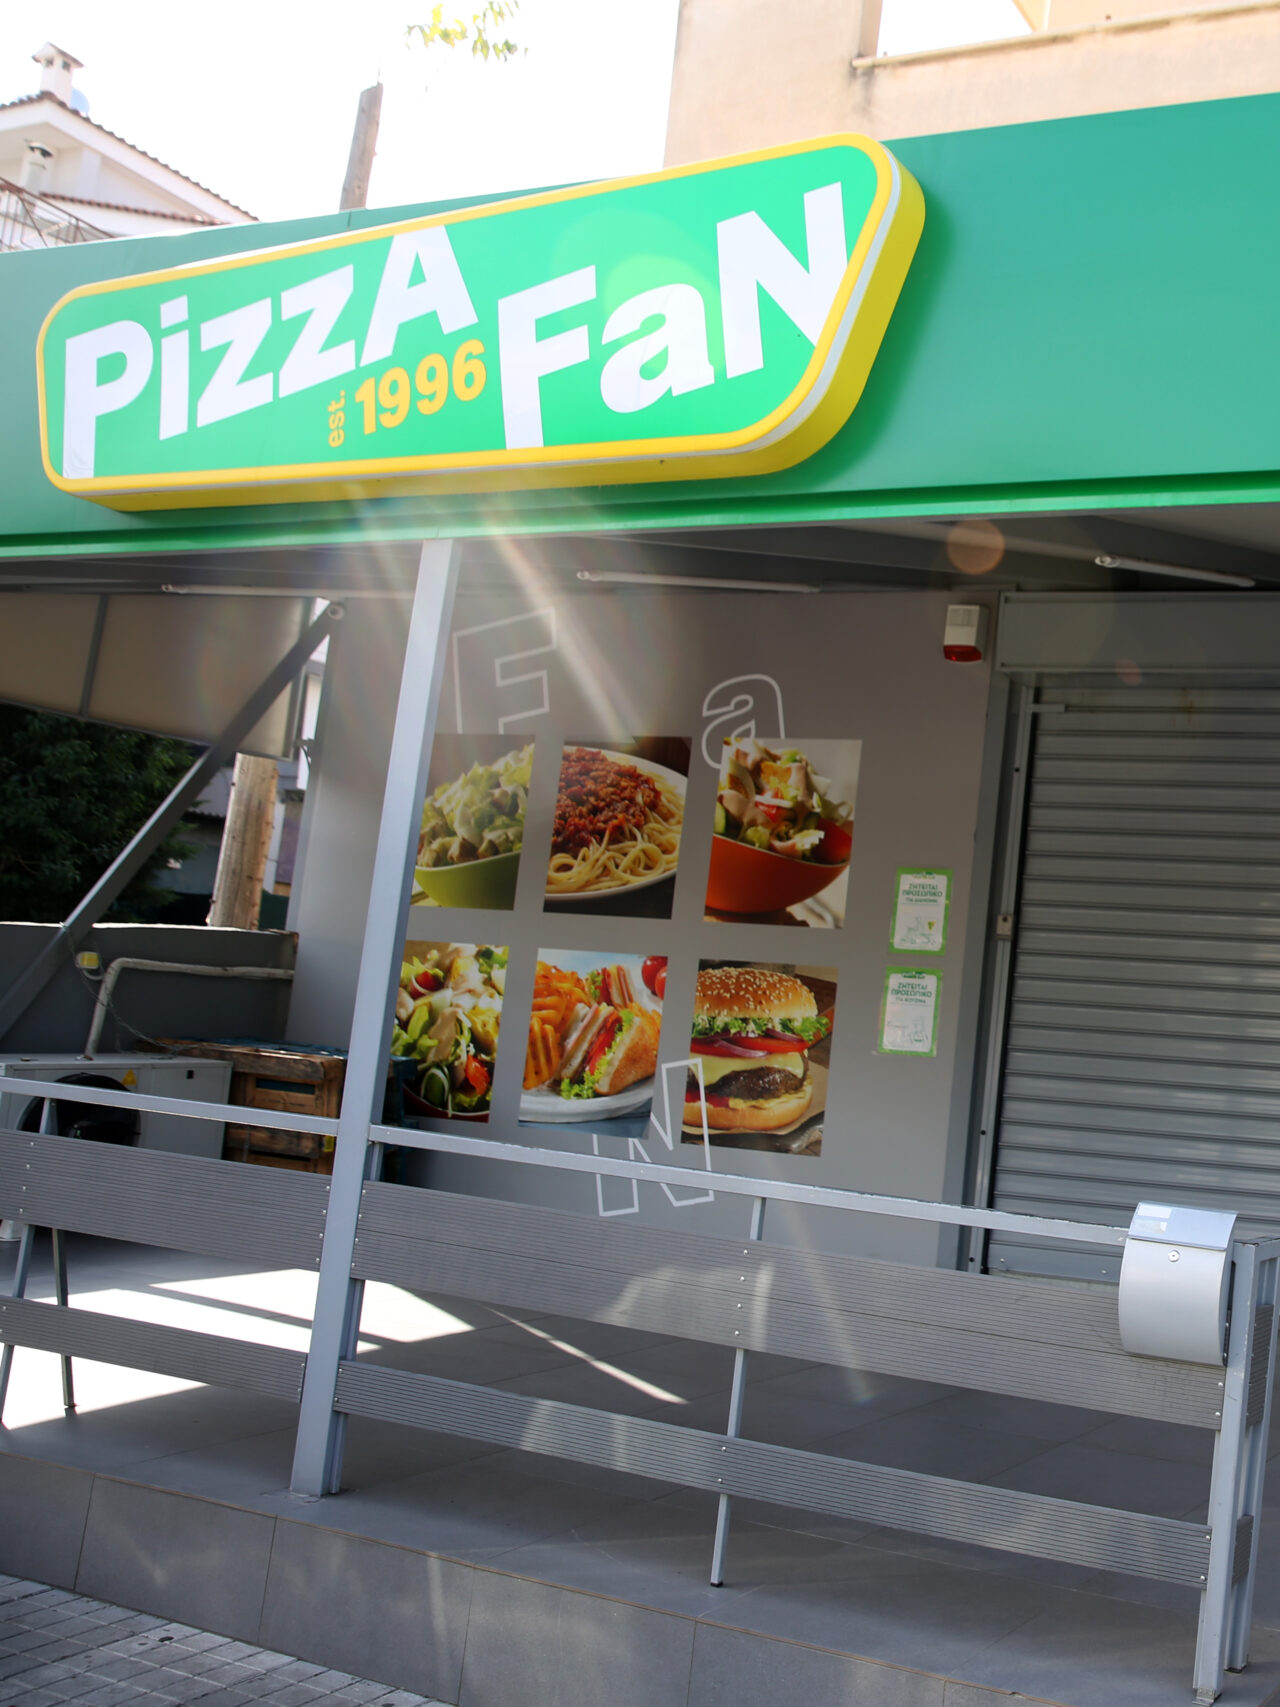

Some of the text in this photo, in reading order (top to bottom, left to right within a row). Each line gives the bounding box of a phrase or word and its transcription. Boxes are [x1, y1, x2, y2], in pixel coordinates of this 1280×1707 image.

[63, 225, 478, 479] PizzA
[355, 339, 487, 435] 1996
[498, 182, 848, 450] FaN
[328, 390, 346, 448] est.
